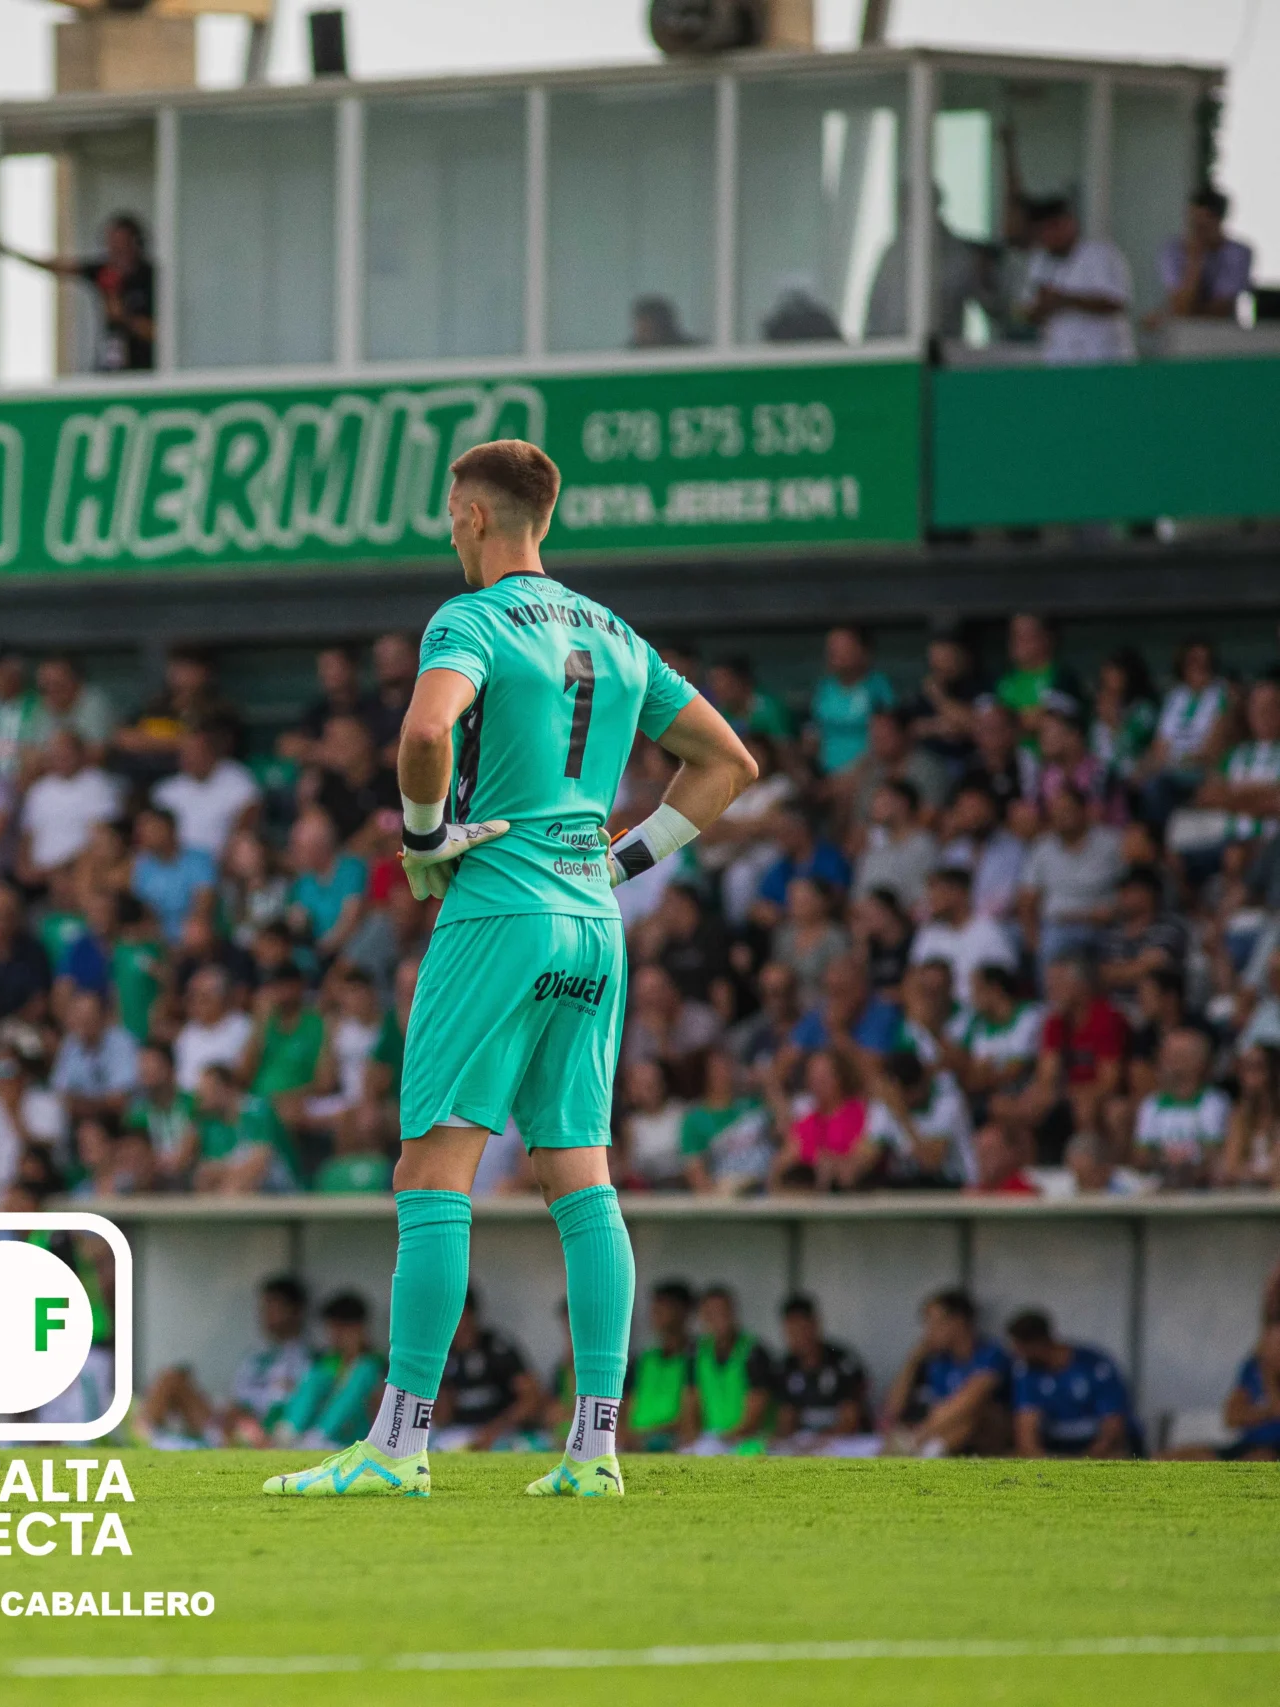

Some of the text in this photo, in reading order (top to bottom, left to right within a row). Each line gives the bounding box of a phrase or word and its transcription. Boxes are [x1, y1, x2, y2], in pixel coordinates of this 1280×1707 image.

[581, 400, 836, 464] 678 575 530
[504, 602, 630, 646] KUDAKOVSKY
[563, 649, 596, 780] 1
[553, 856, 602, 878] dacom
[596, 1404, 618, 1431] FS
